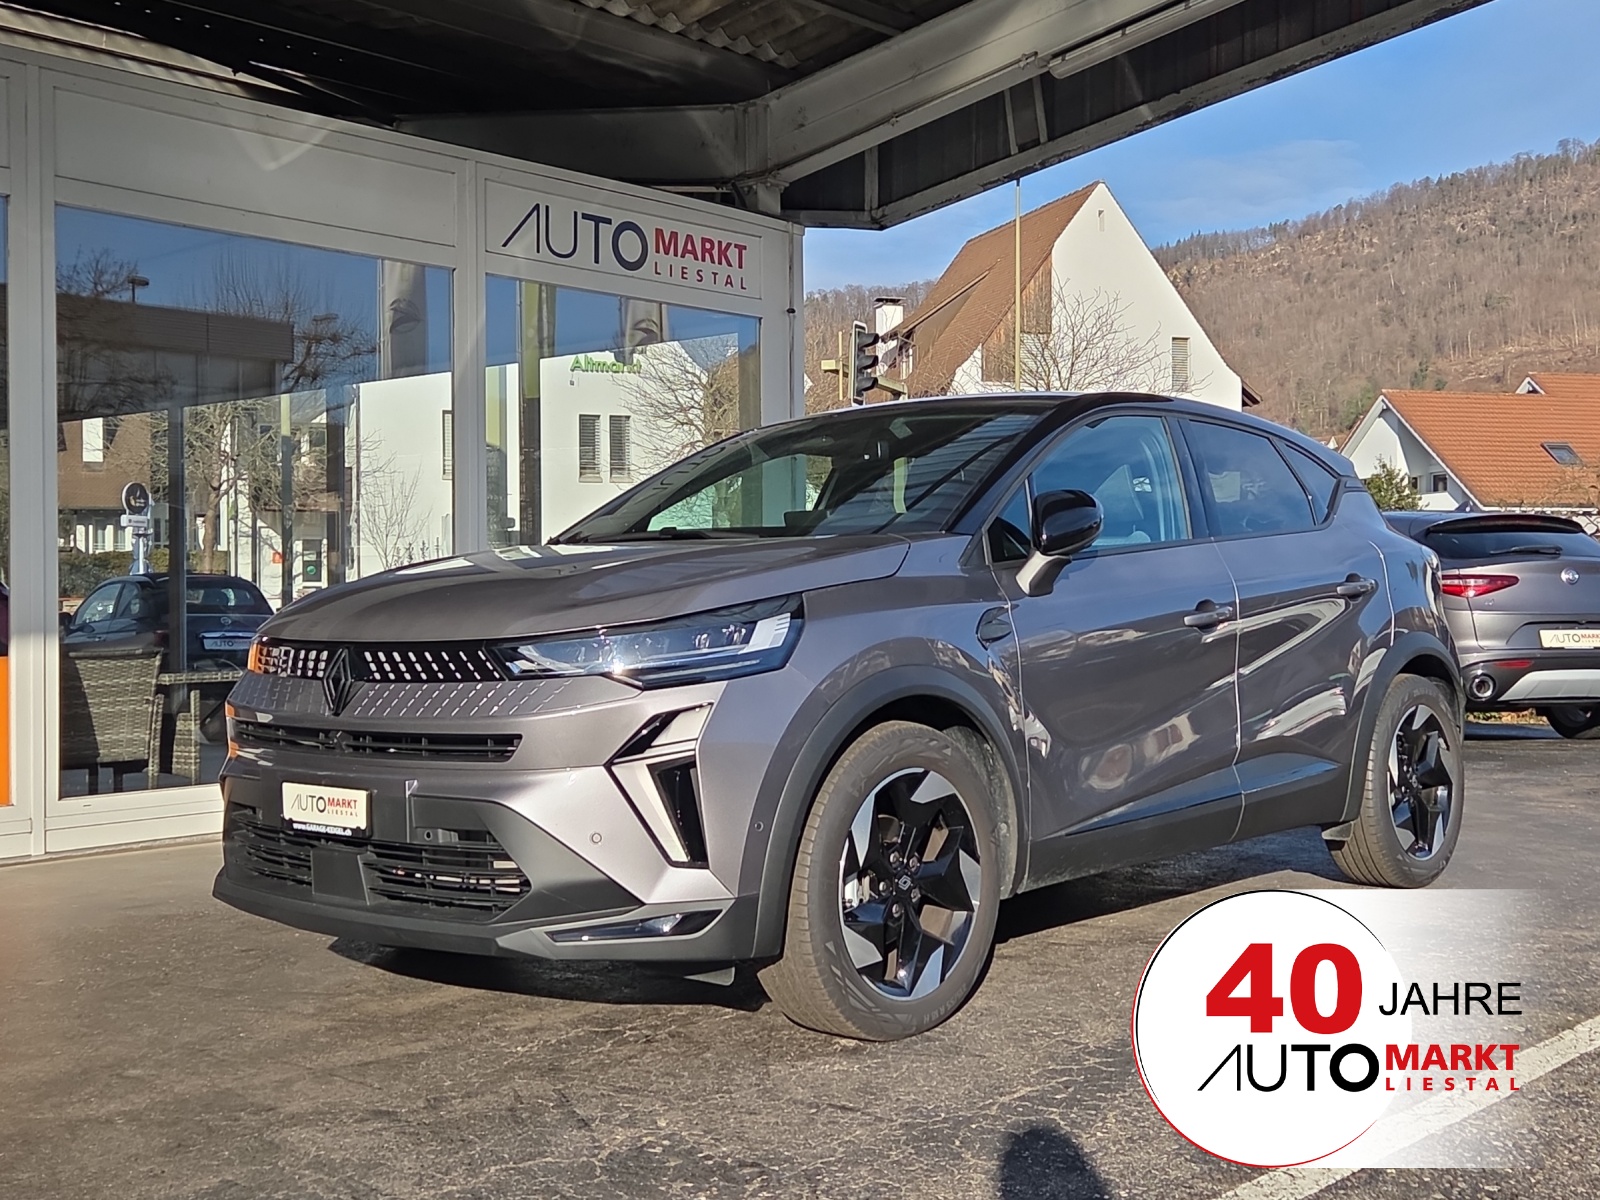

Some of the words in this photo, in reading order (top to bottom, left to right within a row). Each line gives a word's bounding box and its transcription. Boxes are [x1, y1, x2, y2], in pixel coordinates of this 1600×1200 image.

[501, 203, 649, 271] AUTO
[654, 227, 748, 269] MARKT
[654, 261, 747, 290] LIESTAL
[1550, 633, 1581, 643] AUTO
[291, 793, 327, 813] AUTO
[327, 797, 358, 809] MARKT
[327, 809, 358, 817] LIESTAL
